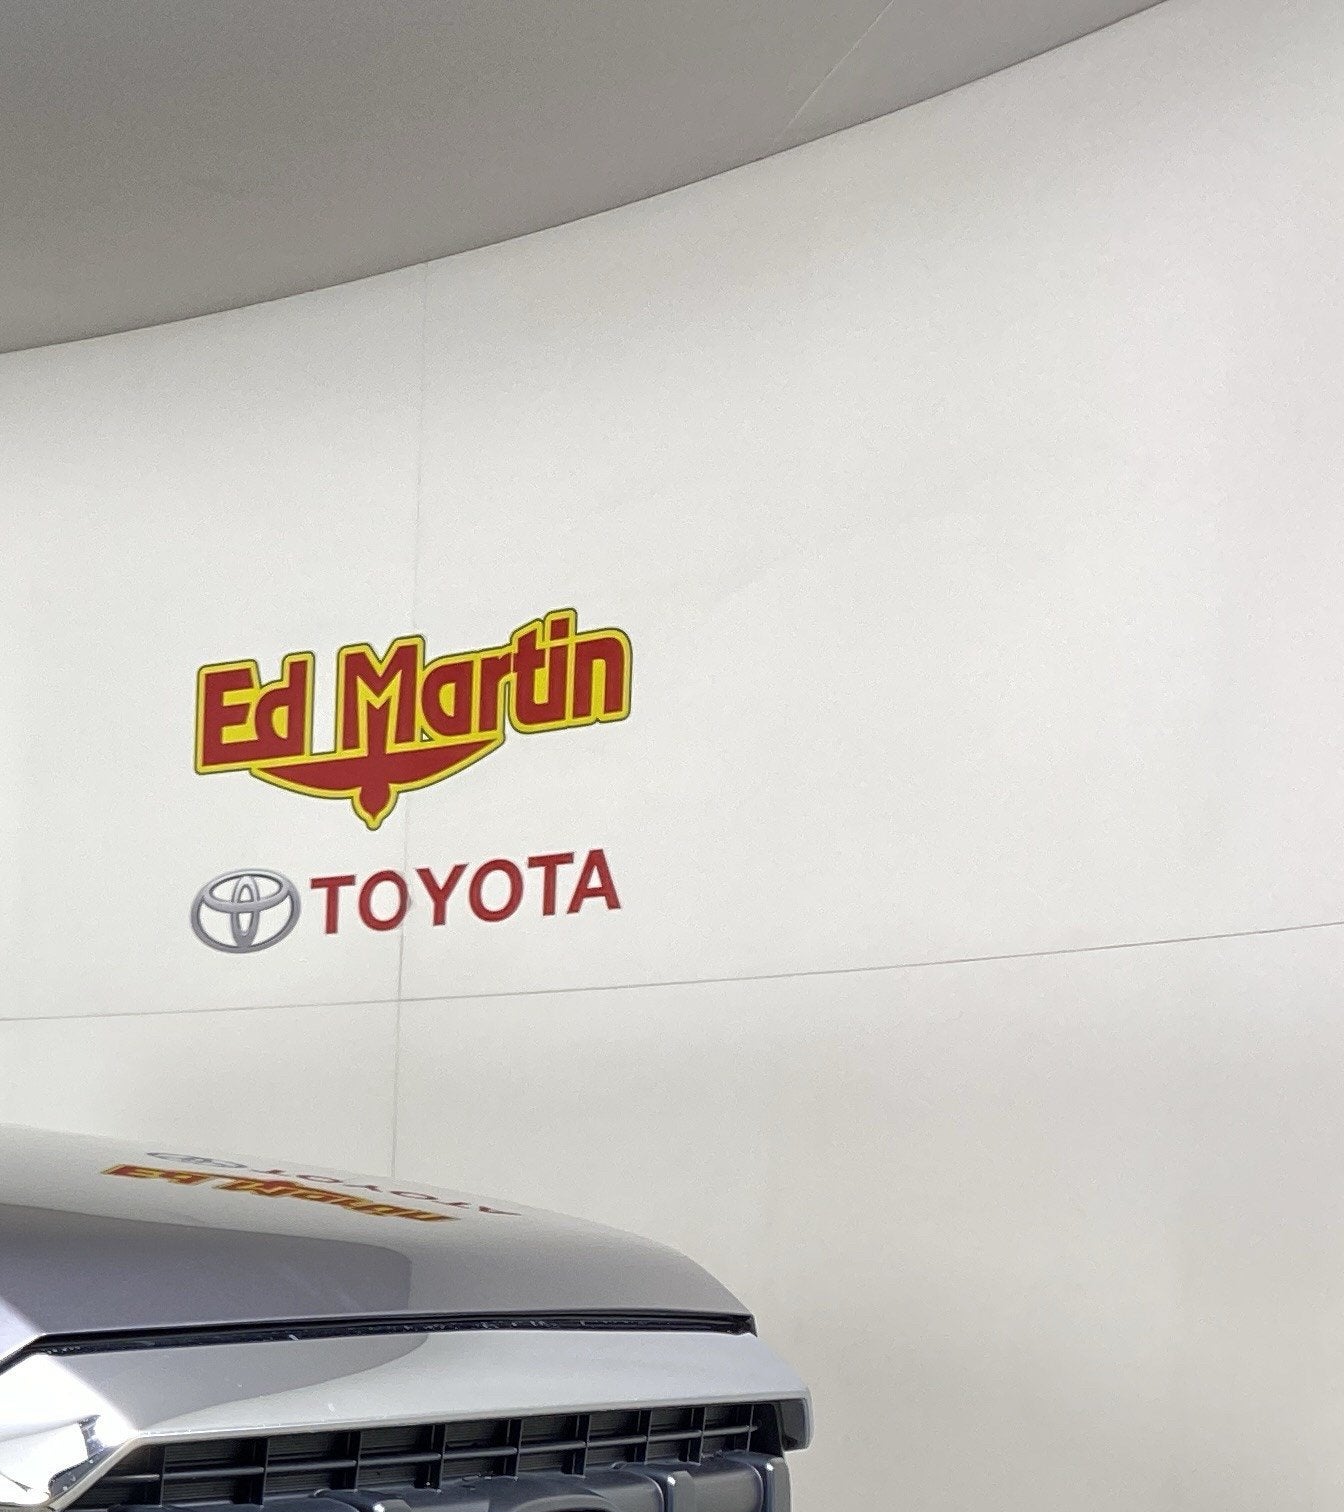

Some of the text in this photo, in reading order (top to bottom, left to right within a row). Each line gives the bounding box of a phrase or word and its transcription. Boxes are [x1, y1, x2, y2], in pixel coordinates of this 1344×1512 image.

[201, 616, 626, 767] Ed Martin
[310, 848, 621, 935] TOYOTA
